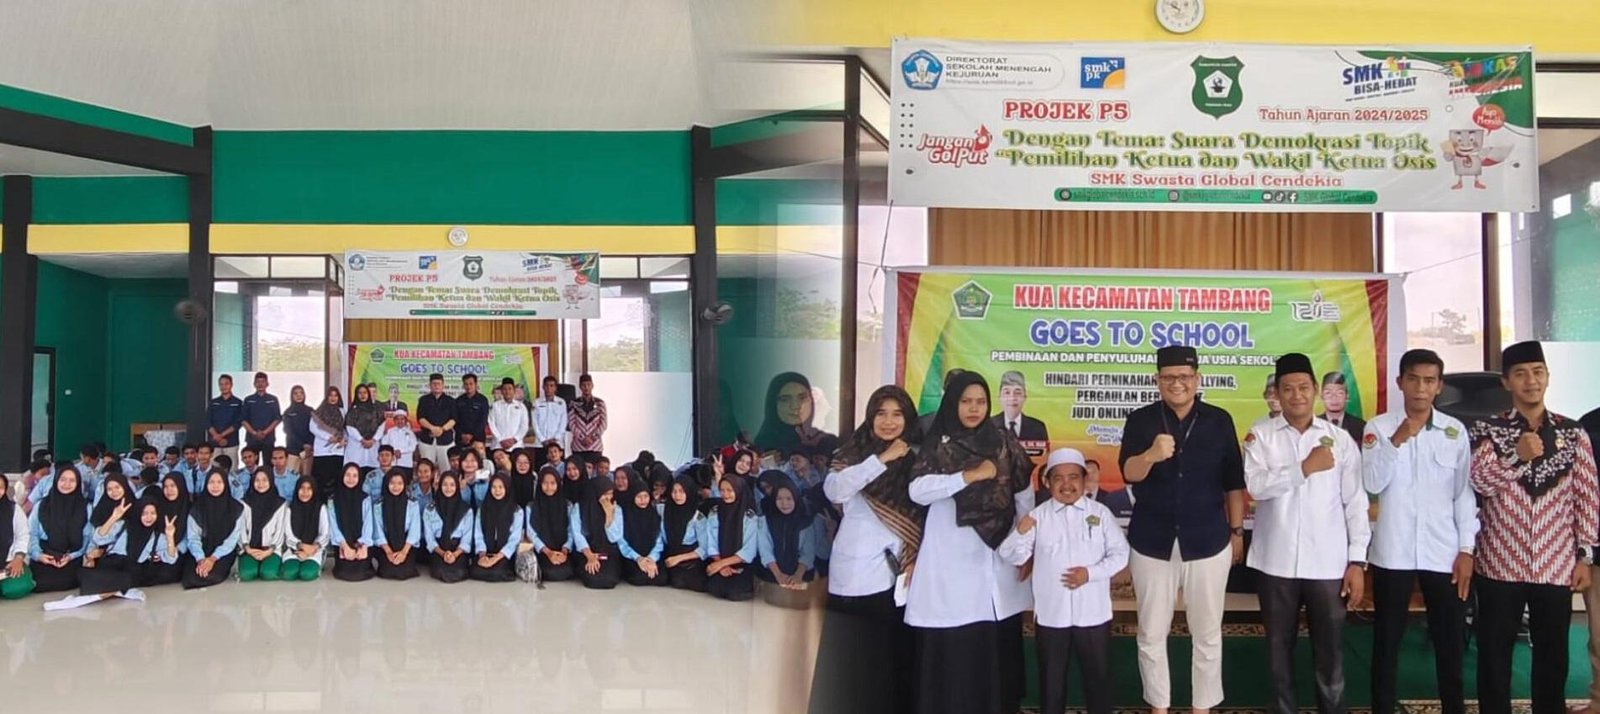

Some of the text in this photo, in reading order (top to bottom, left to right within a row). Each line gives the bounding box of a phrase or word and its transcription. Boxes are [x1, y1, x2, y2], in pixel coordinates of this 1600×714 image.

[946, 56, 1008, 64] DIREKTORAT
[1085, 61, 1111, 72] smk
[946, 63, 1052, 72] SEKOLAH MENENGAH
[1342, 62, 1382, 85] SMK
[1086, 71, 1101, 81] pk
[1354, 77, 1417, 94] BISA-HEBAT
[1004, 101, 1128, 120] PROJEK P5
[1259, 108, 1428, 123] Tahun Ajaran 2024/2025
[916, 133, 974, 151] Jangan
[1002, 129, 1433, 154] Dengan Tema: Suara Demokrasi Topik
[1123, 150, 1193, 169] Ketua
[1199, 152, 1239, 169] dan
[1243, 152, 1312, 171] Wakil
[1317, 151, 1385, 171] Ketua
[1392, 153, 1438, 170] Osis
[1090, 173, 1342, 187] SMK Swasta Global Cendekia
[1014, 285, 1054, 308] KUA
[1058, 286, 1172, 310] KECAMATAN
[1178, 288, 1271, 312] TAMBANG
[1030, 319, 1254, 349] GOES TO SCHOOL
[991, 352, 1059, 362] PEMBINAAN
[1060, 352, 1084, 362] DAN
[1212, 355, 1238, 364] USIA
[1240, 355, 1277, 365] SEKOL
[400, 363, 487, 374] GOES TO SCHOOL
[1045, 373, 1089, 385] HINDARI
[1077, 390, 1137, 402] PERGAULAN
[1072, 406, 1134, 419] JUDI ONLIN
